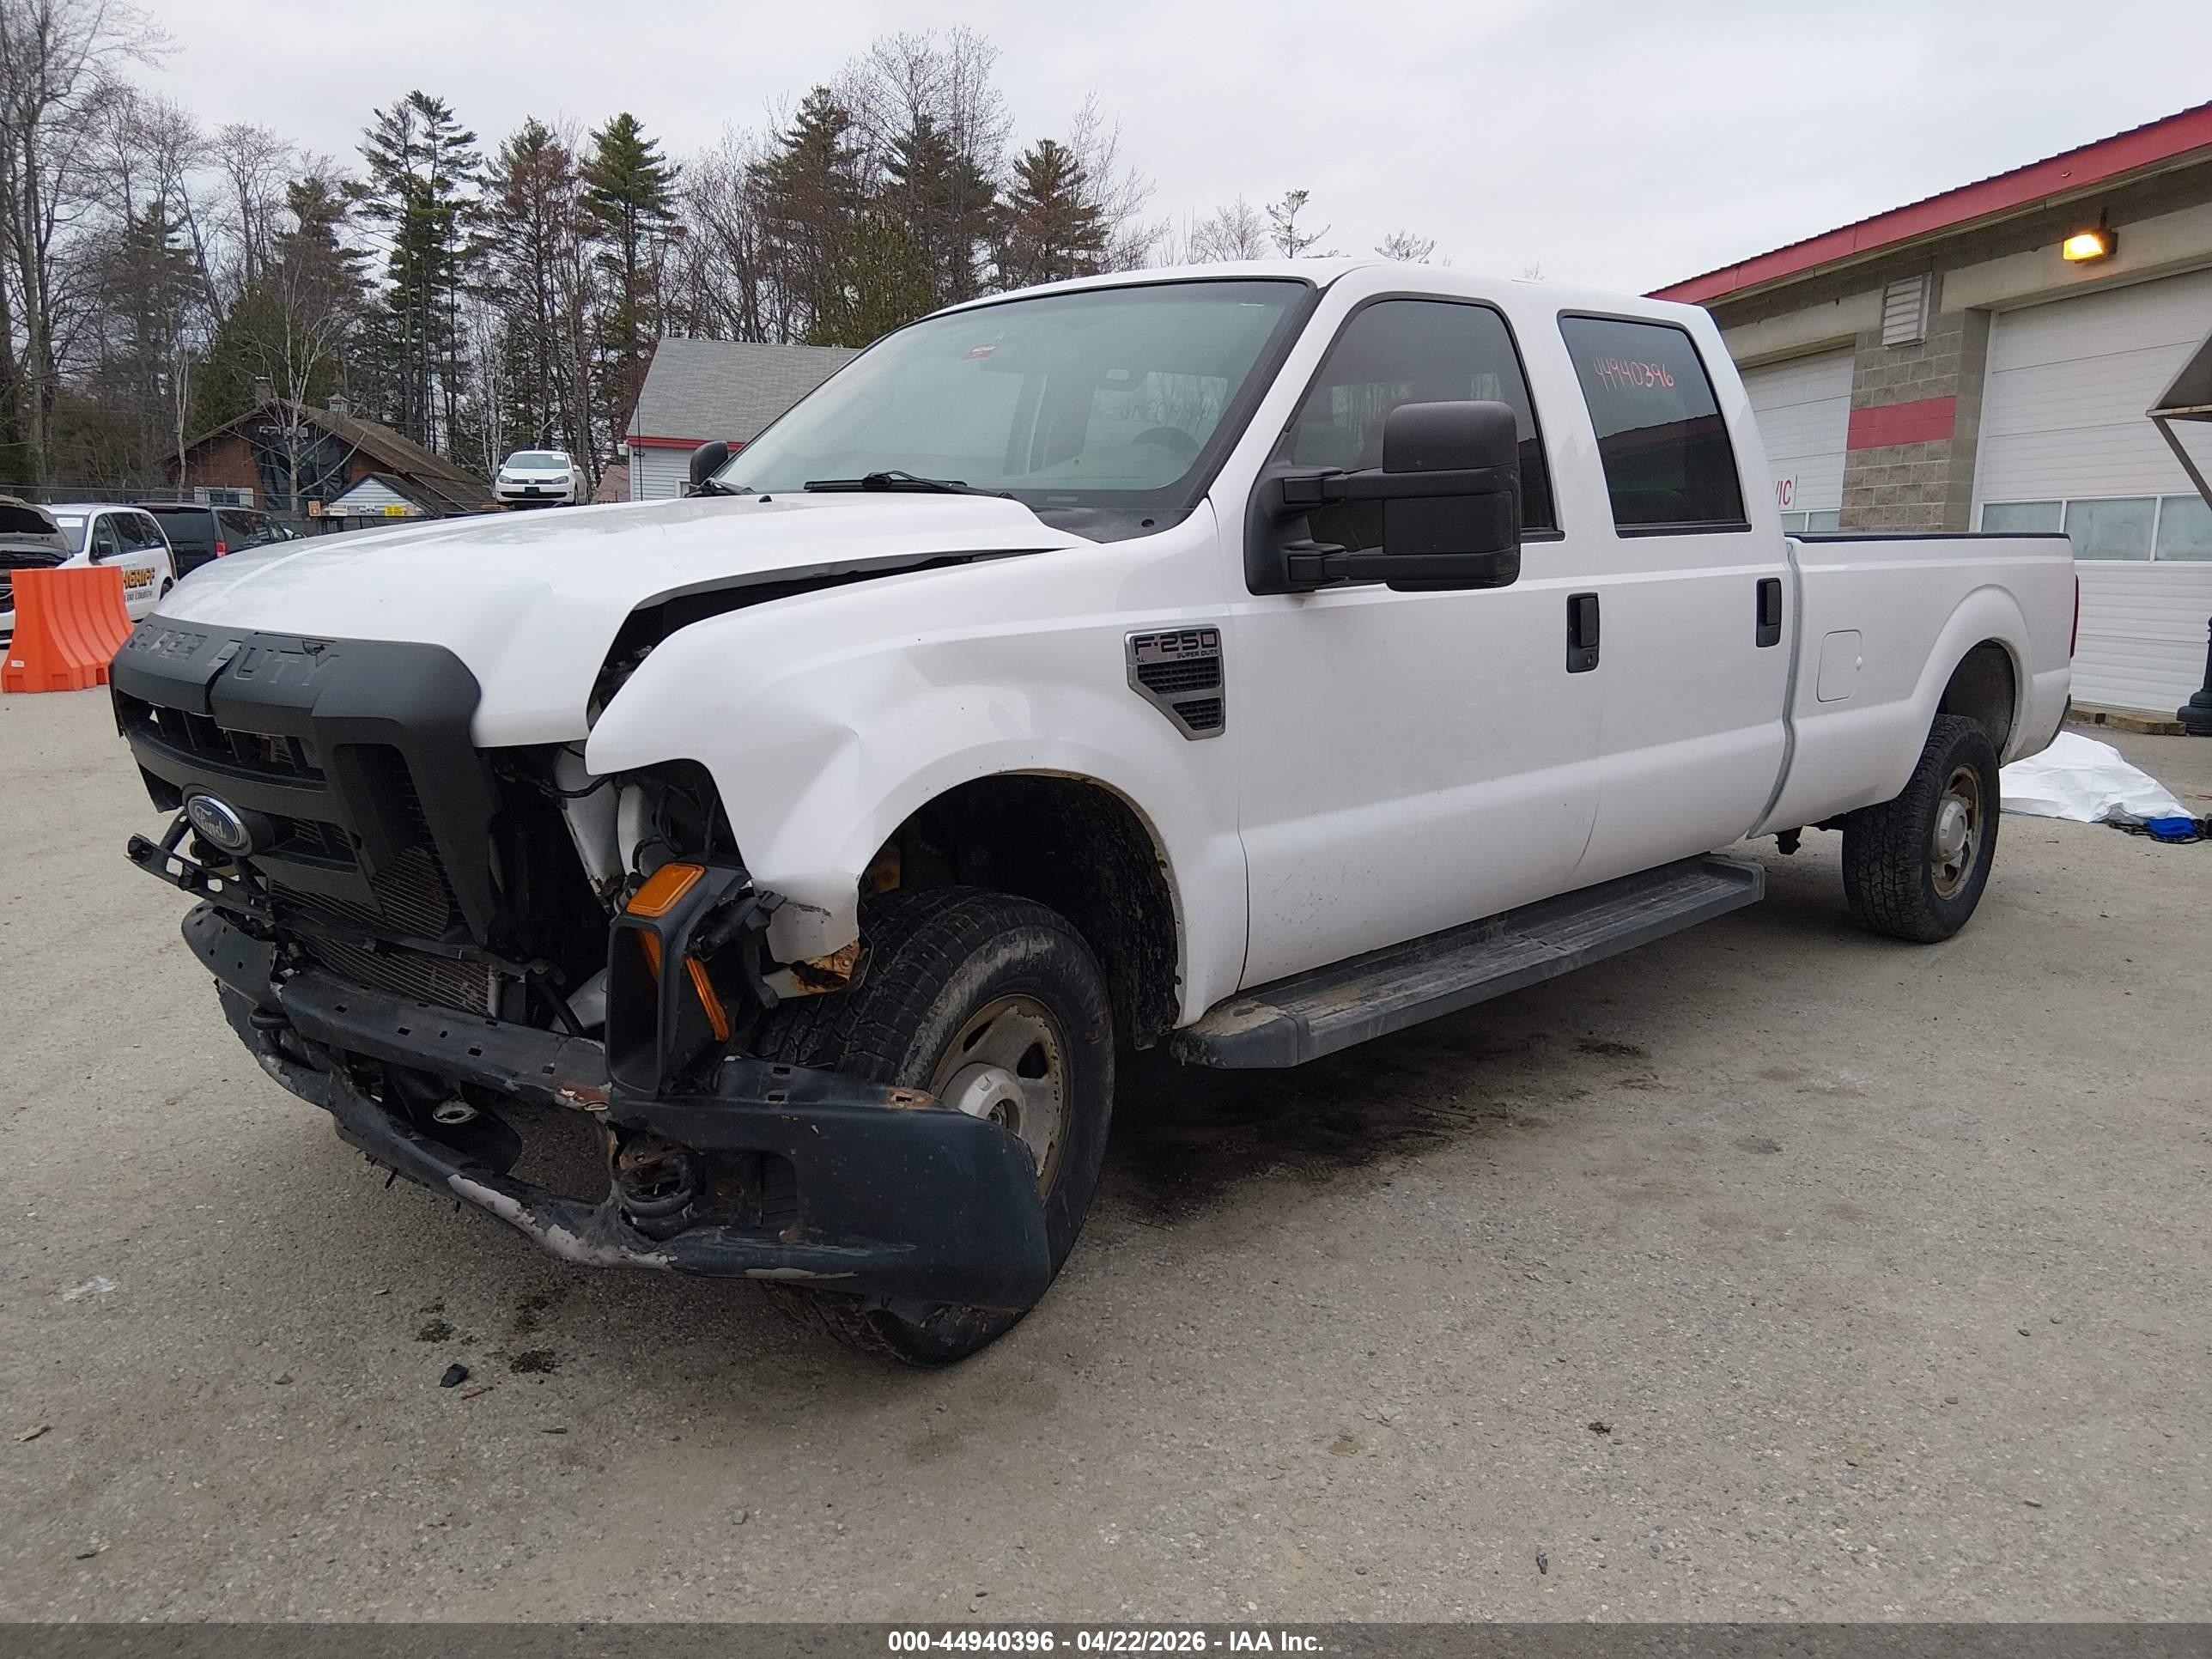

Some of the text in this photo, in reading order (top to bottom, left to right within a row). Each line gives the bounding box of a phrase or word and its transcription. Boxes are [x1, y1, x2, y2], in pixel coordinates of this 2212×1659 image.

[1593, 356, 1674, 391] 44940396
[124, 568, 155, 589] HERIFF
[195, 805, 227, 839] Ford
